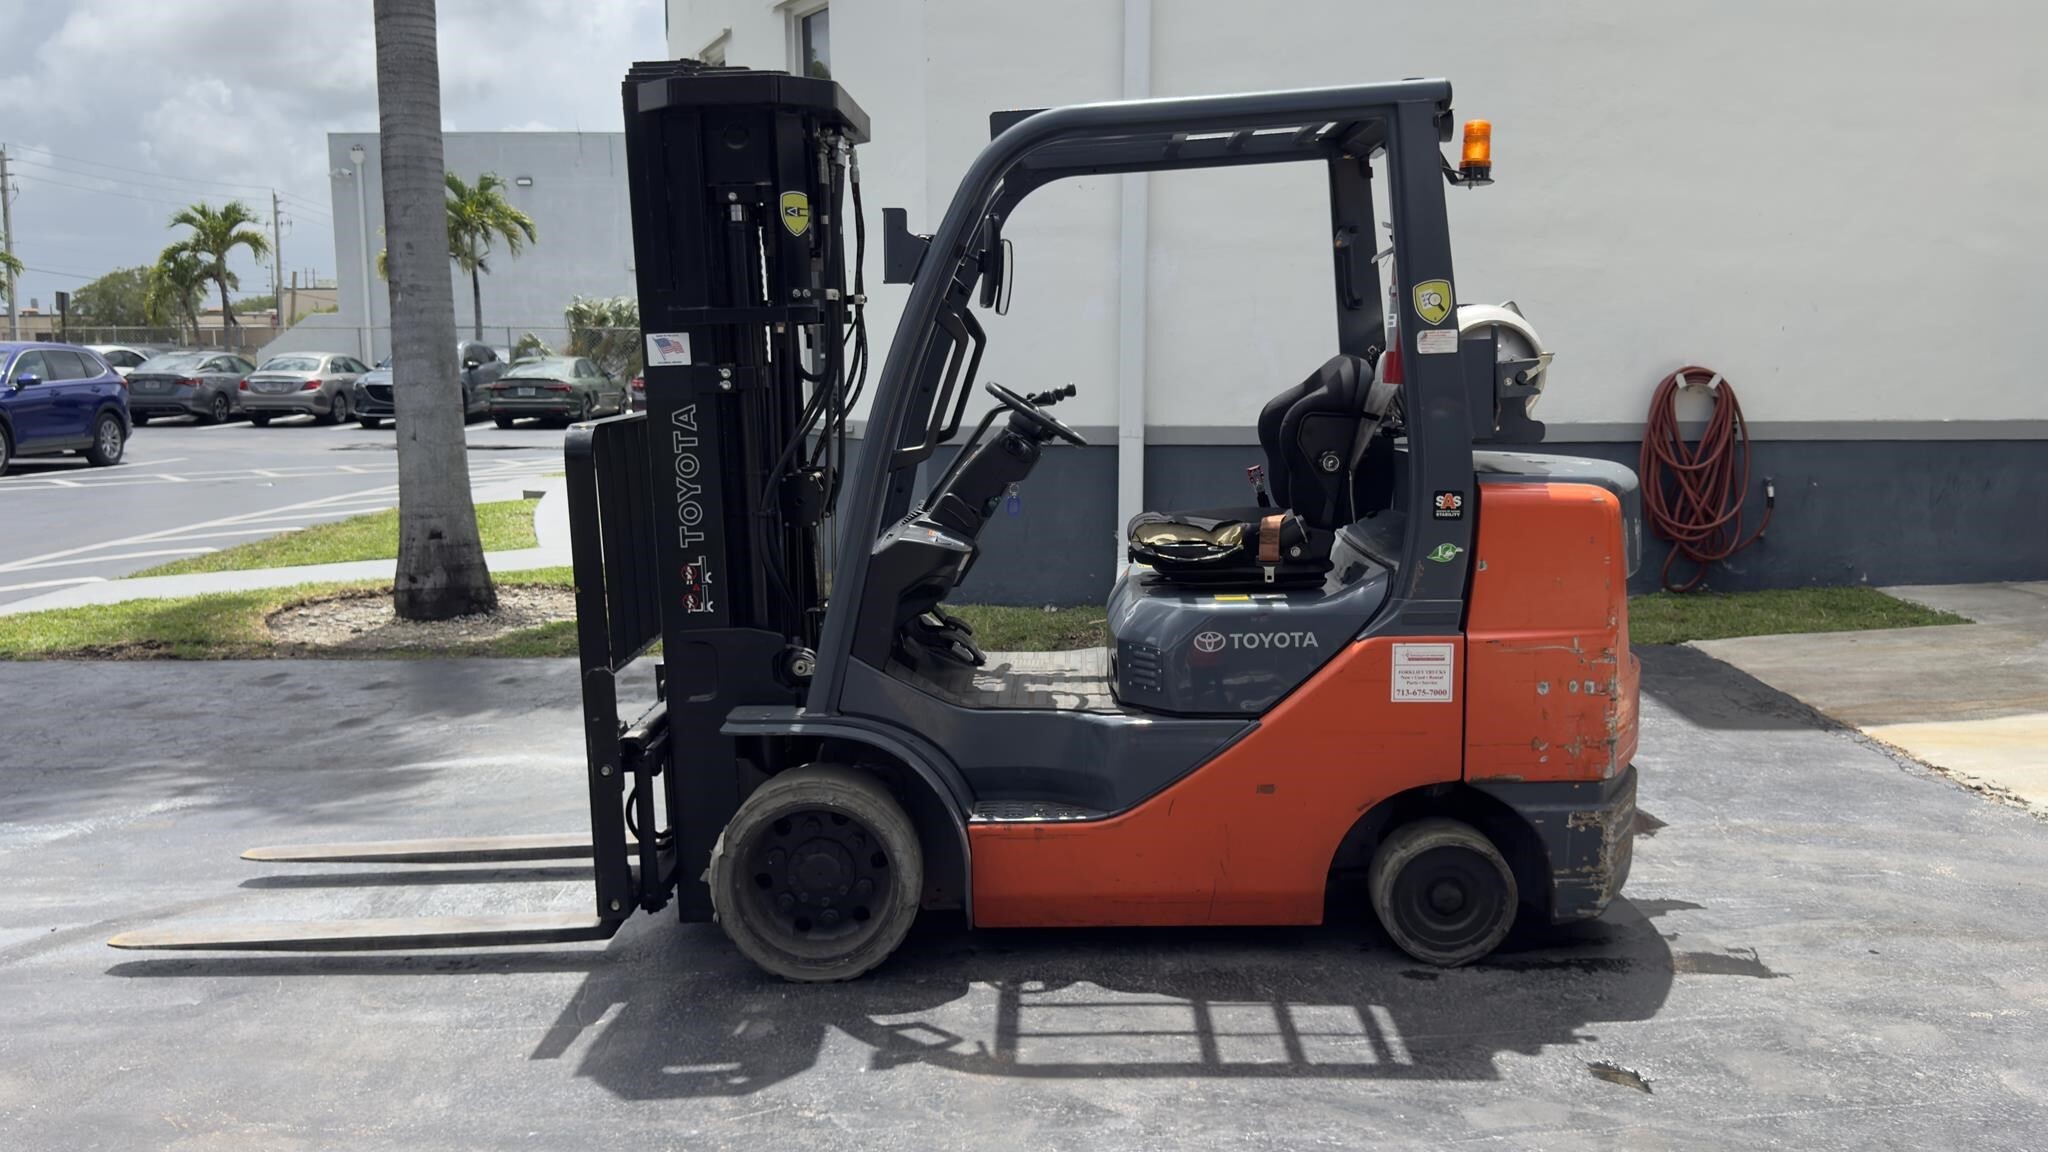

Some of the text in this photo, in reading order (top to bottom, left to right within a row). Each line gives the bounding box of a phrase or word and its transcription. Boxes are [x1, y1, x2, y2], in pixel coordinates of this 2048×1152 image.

[672, 404, 704, 548] TOYOTA
[1435, 493, 1462, 509] SAS
[1229, 631, 1319, 649] TOYOTA
